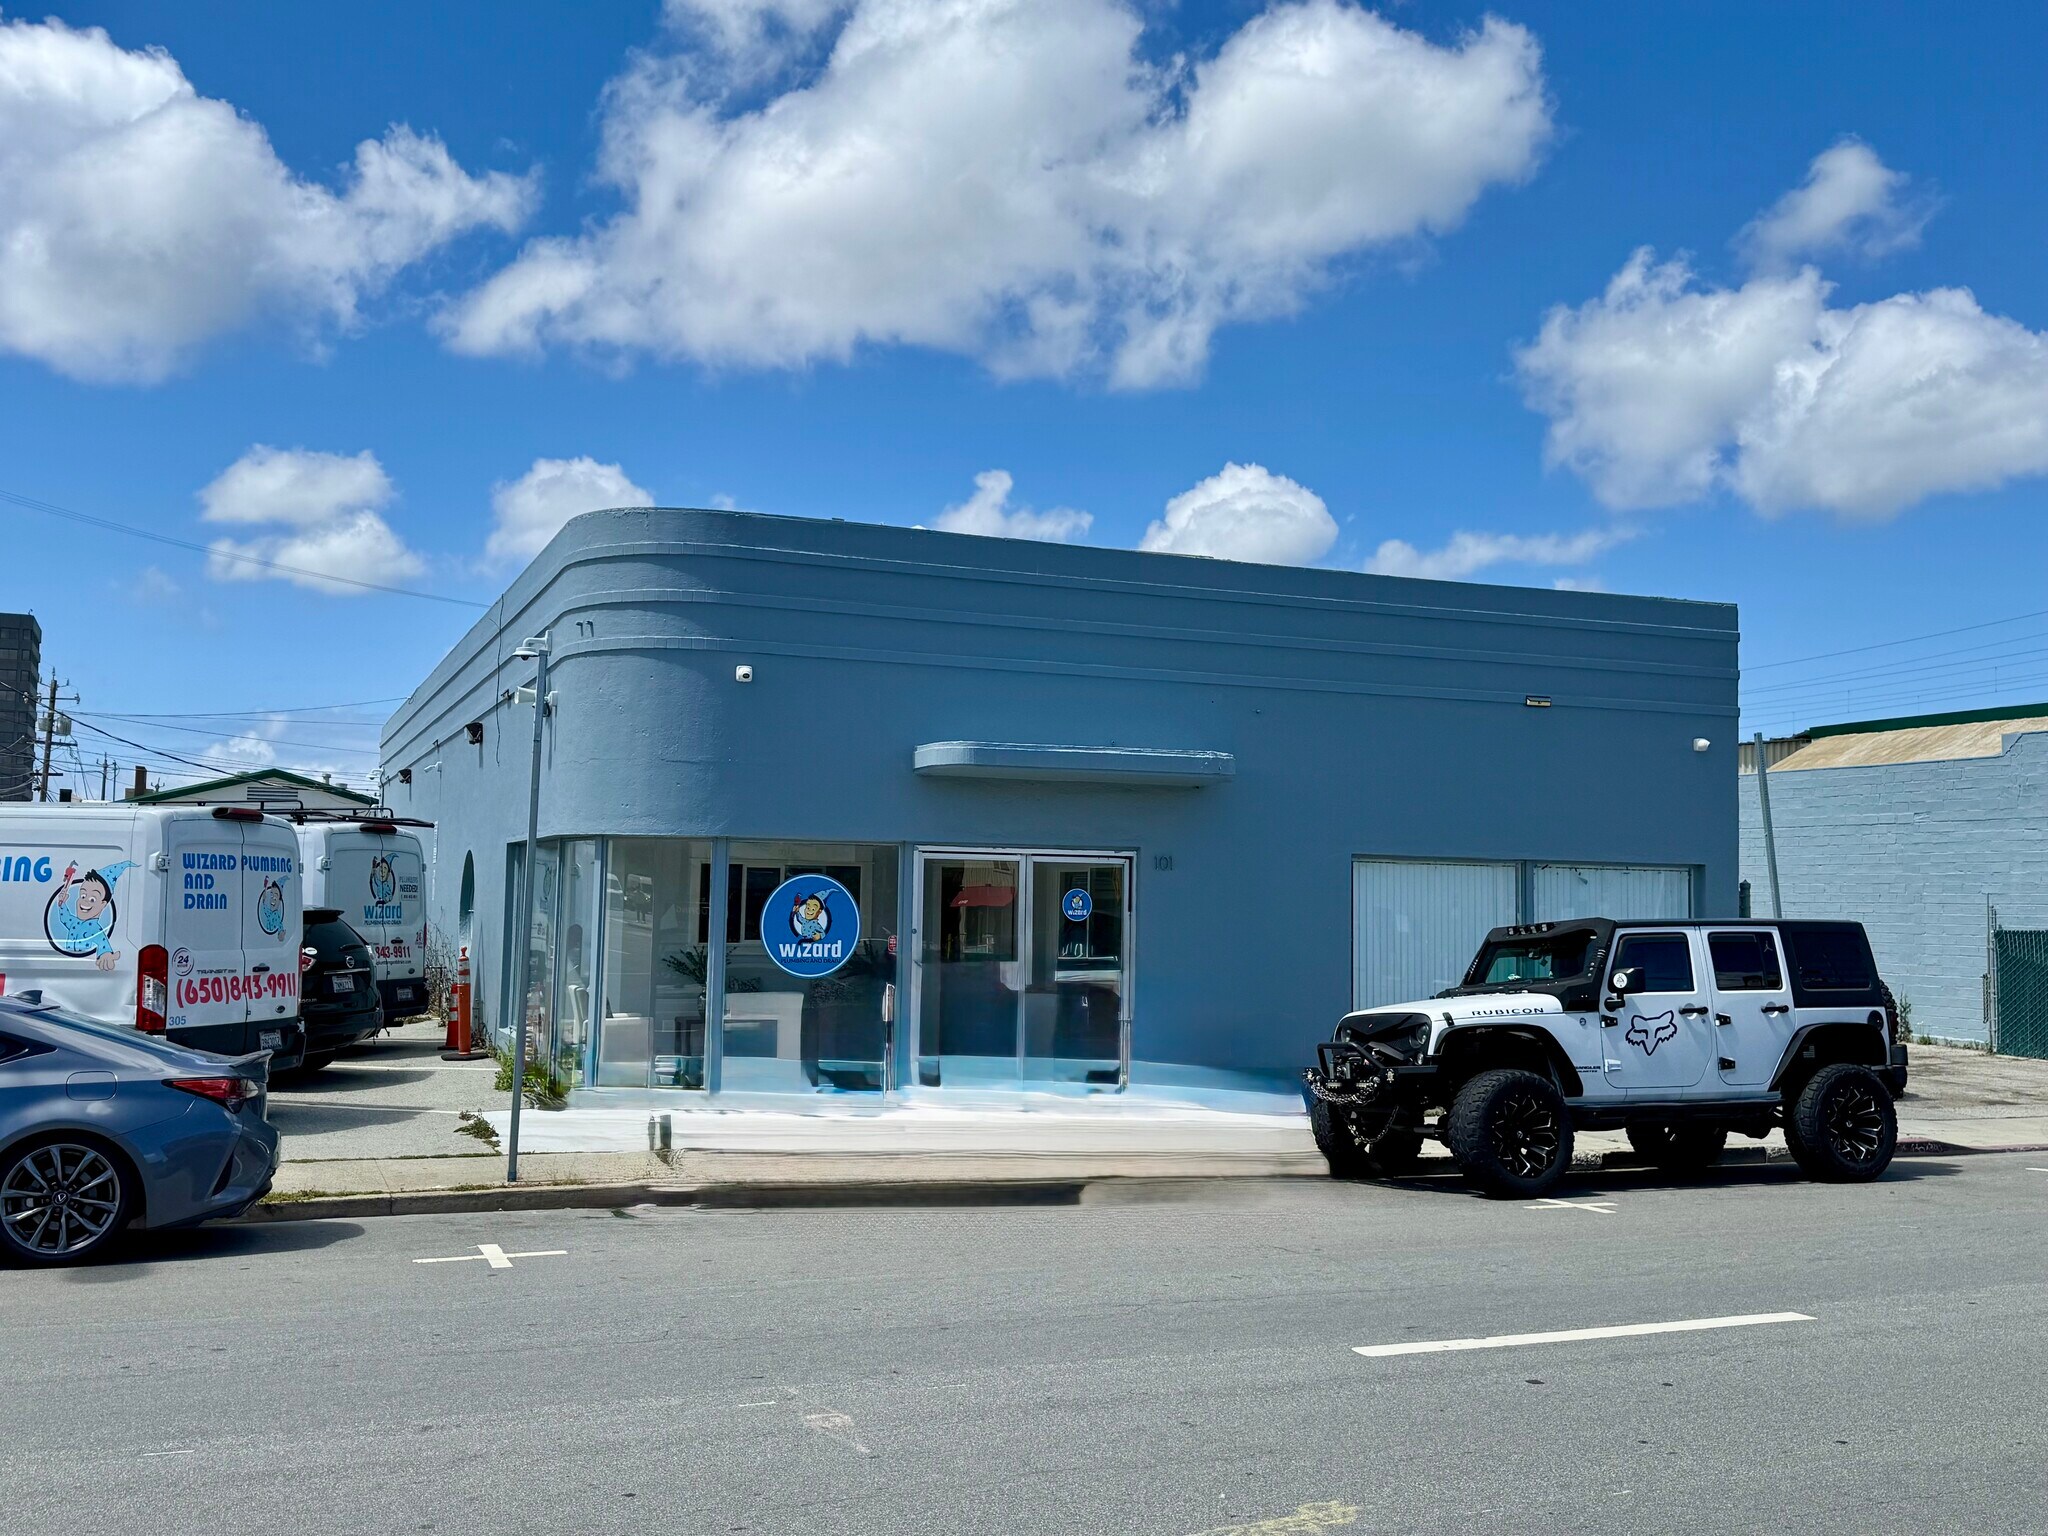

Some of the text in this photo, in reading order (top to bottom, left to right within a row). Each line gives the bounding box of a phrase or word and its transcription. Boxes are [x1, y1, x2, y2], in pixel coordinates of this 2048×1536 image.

[0, 856, 52, 882] ING
[182, 853, 292, 873] WIZARD PLUMBING
[1154, 855, 1173, 871] 101
[184, 873, 214, 889] AND
[184, 893, 227, 909] DRAIN
[363, 901, 402, 919] wizard
[778, 940, 842, 958] wizard
[177, 955, 189, 964] 24
[176, 973, 297, 1009] (650)843-9911
[1471, 1007, 1544, 1016] RUBICON
[168, 1015, 187, 1026] 305
